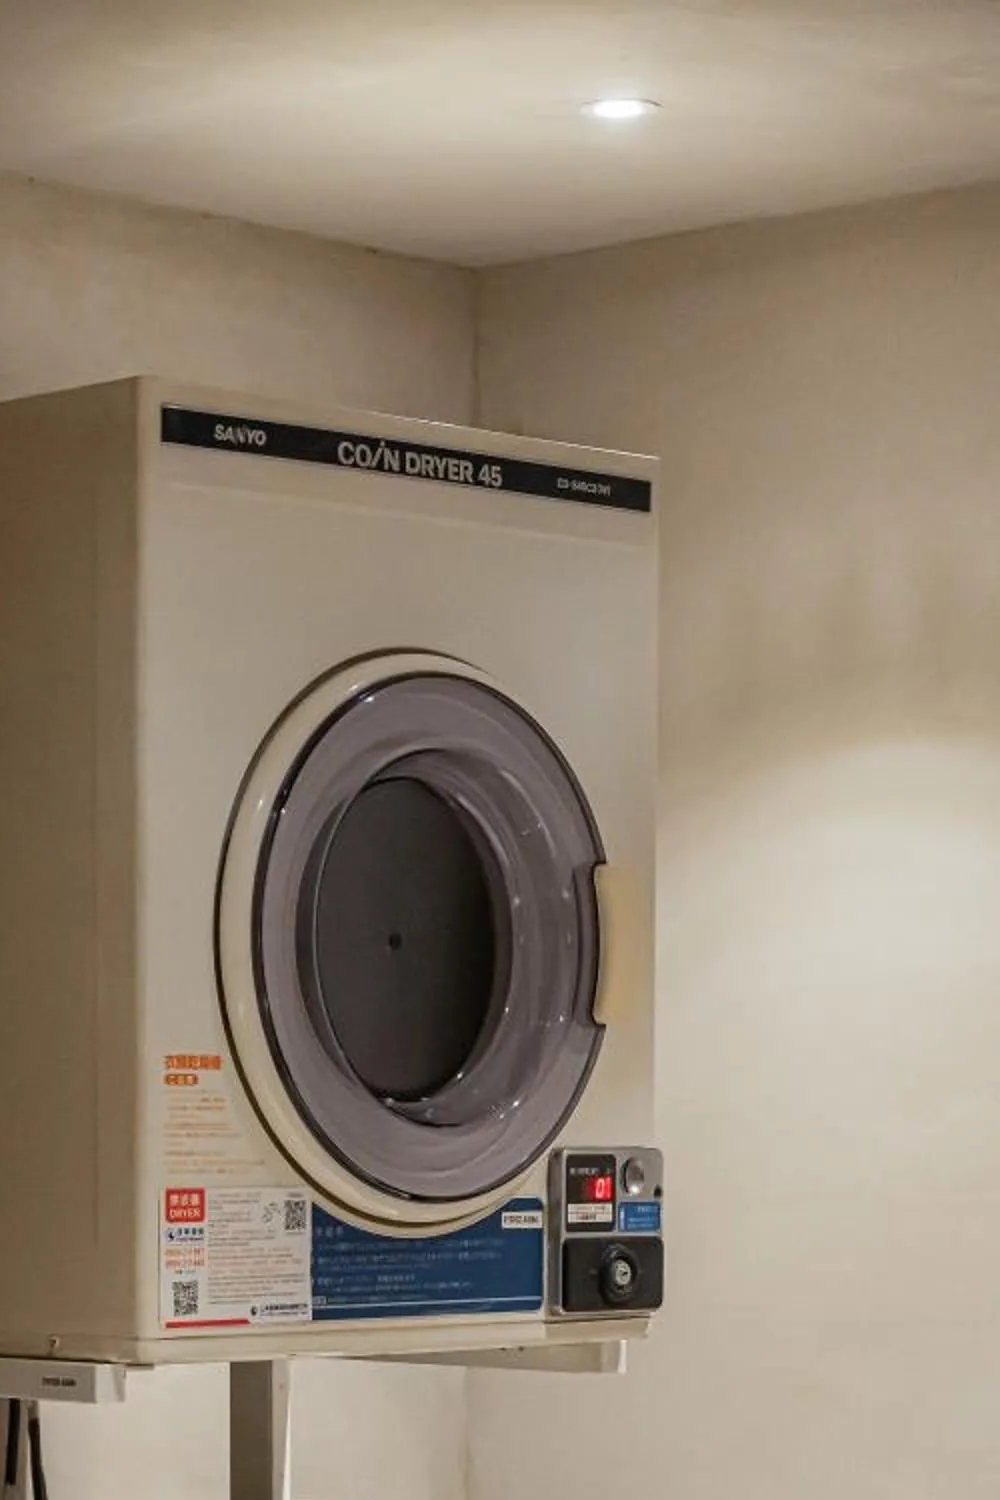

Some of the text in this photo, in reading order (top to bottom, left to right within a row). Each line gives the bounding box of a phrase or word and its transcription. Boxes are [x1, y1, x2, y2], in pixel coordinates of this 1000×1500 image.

[214, 423, 267, 446] SANYO
[405, 451, 474, 483] DRYER
[478, 463, 503, 487] 45
